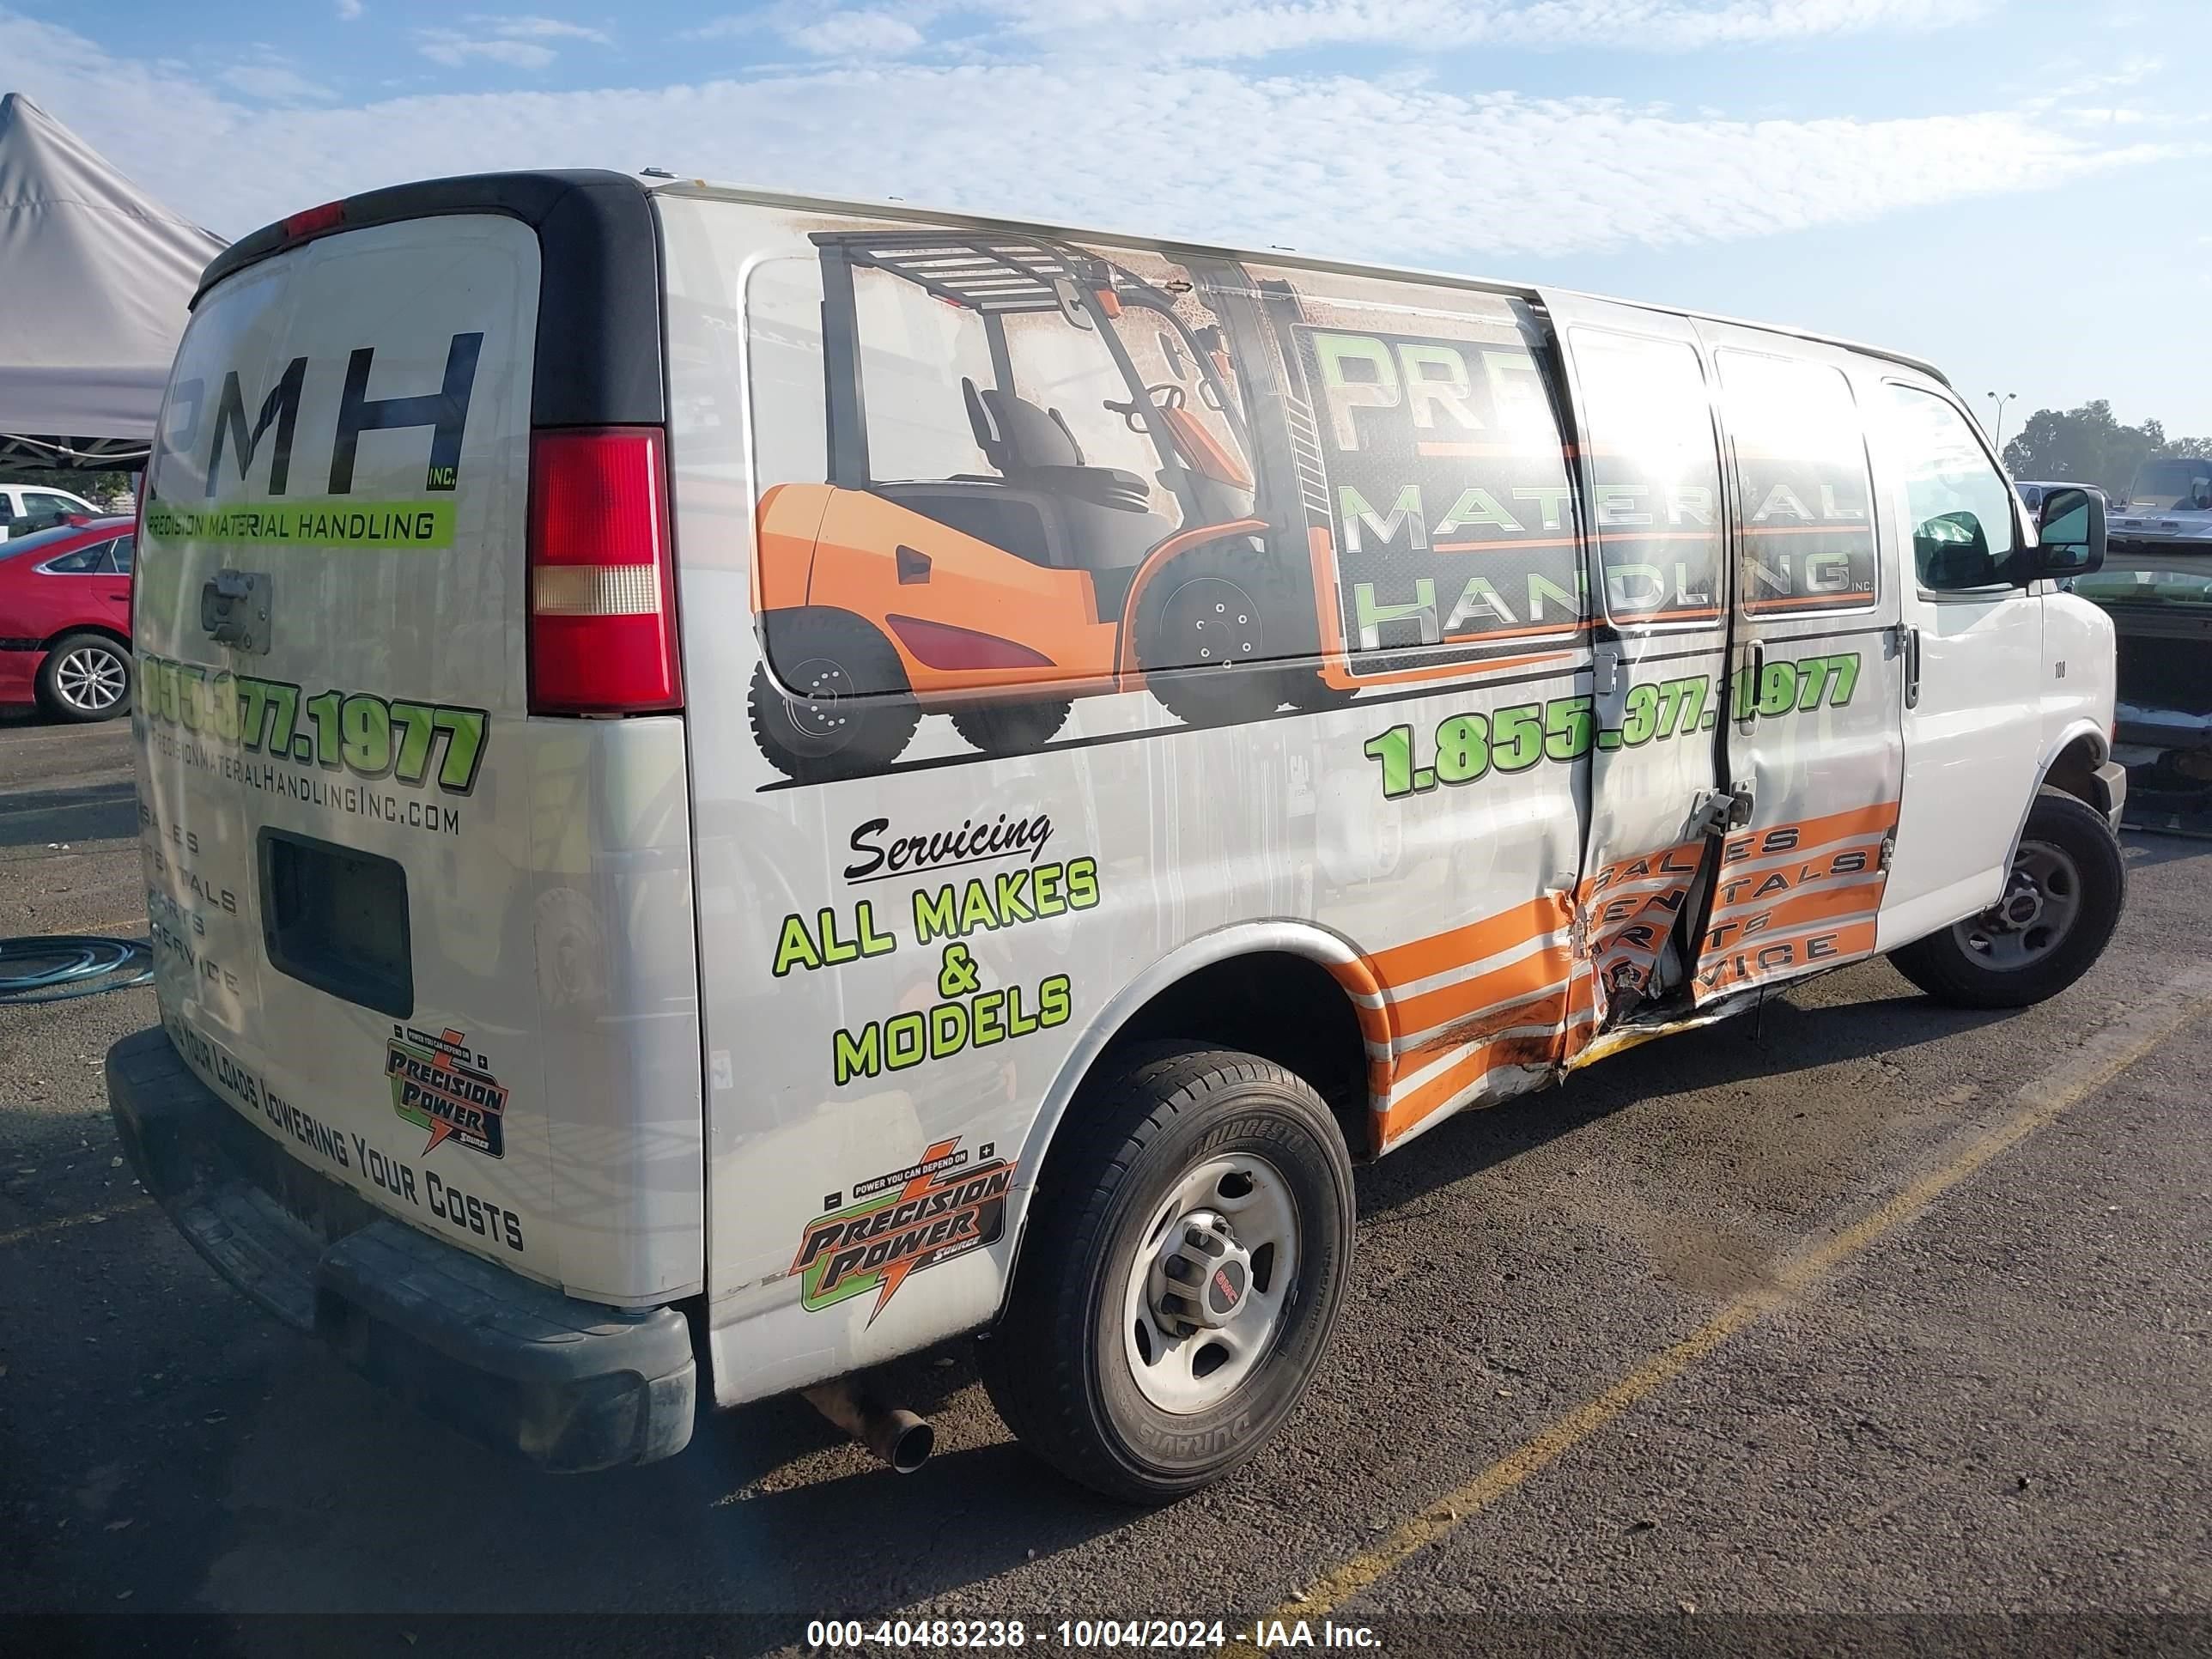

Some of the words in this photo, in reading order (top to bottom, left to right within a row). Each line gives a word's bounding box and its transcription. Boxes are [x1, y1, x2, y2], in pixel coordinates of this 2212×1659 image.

[428, 467, 456, 487] INC.
[209, 514, 289, 538] MATERIAL
[297, 512, 434, 539] HANDLING
[1851, 580, 1874, 592] INC.
[140, 804, 199, 854] SAES
[843, 813, 1054, 879] Servicing
[772, 899, 896, 977] ALL
[913, 856, 1101, 944] MAKES
[939, 940, 981, 999] &
[408, 1031, 425, 1042] POWER
[424, 1036, 434, 1048] YOU
[433, 1039, 444, 1050] CAN
[443, 1042, 462, 1057] DEPEND
[461, 1049, 470, 1060] ON
[834, 974, 1073, 1086] MODELS
[388, 1049, 504, 1110] PRECISION
[401, 1080, 483, 1133] POWER
[212, 1044, 259, 1110] LOADS
[259, 1079, 349, 1169] LOWERING
[351, 1133, 419, 1206] YOUR
[426, 1170, 524, 1252] COSTS
[855, 1179, 886, 1196] POWER
[886, 1174, 903, 1186] YOU
[904, 1167, 921, 1180] CAN
[921, 1157, 954, 1174] DEPEND
[954, 1152, 967, 1163] ON
[799, 1170, 1016, 1267] PRECISION
[822, 1209, 978, 1289] POWER
[1215, 1271, 1238, 1304] GMC
